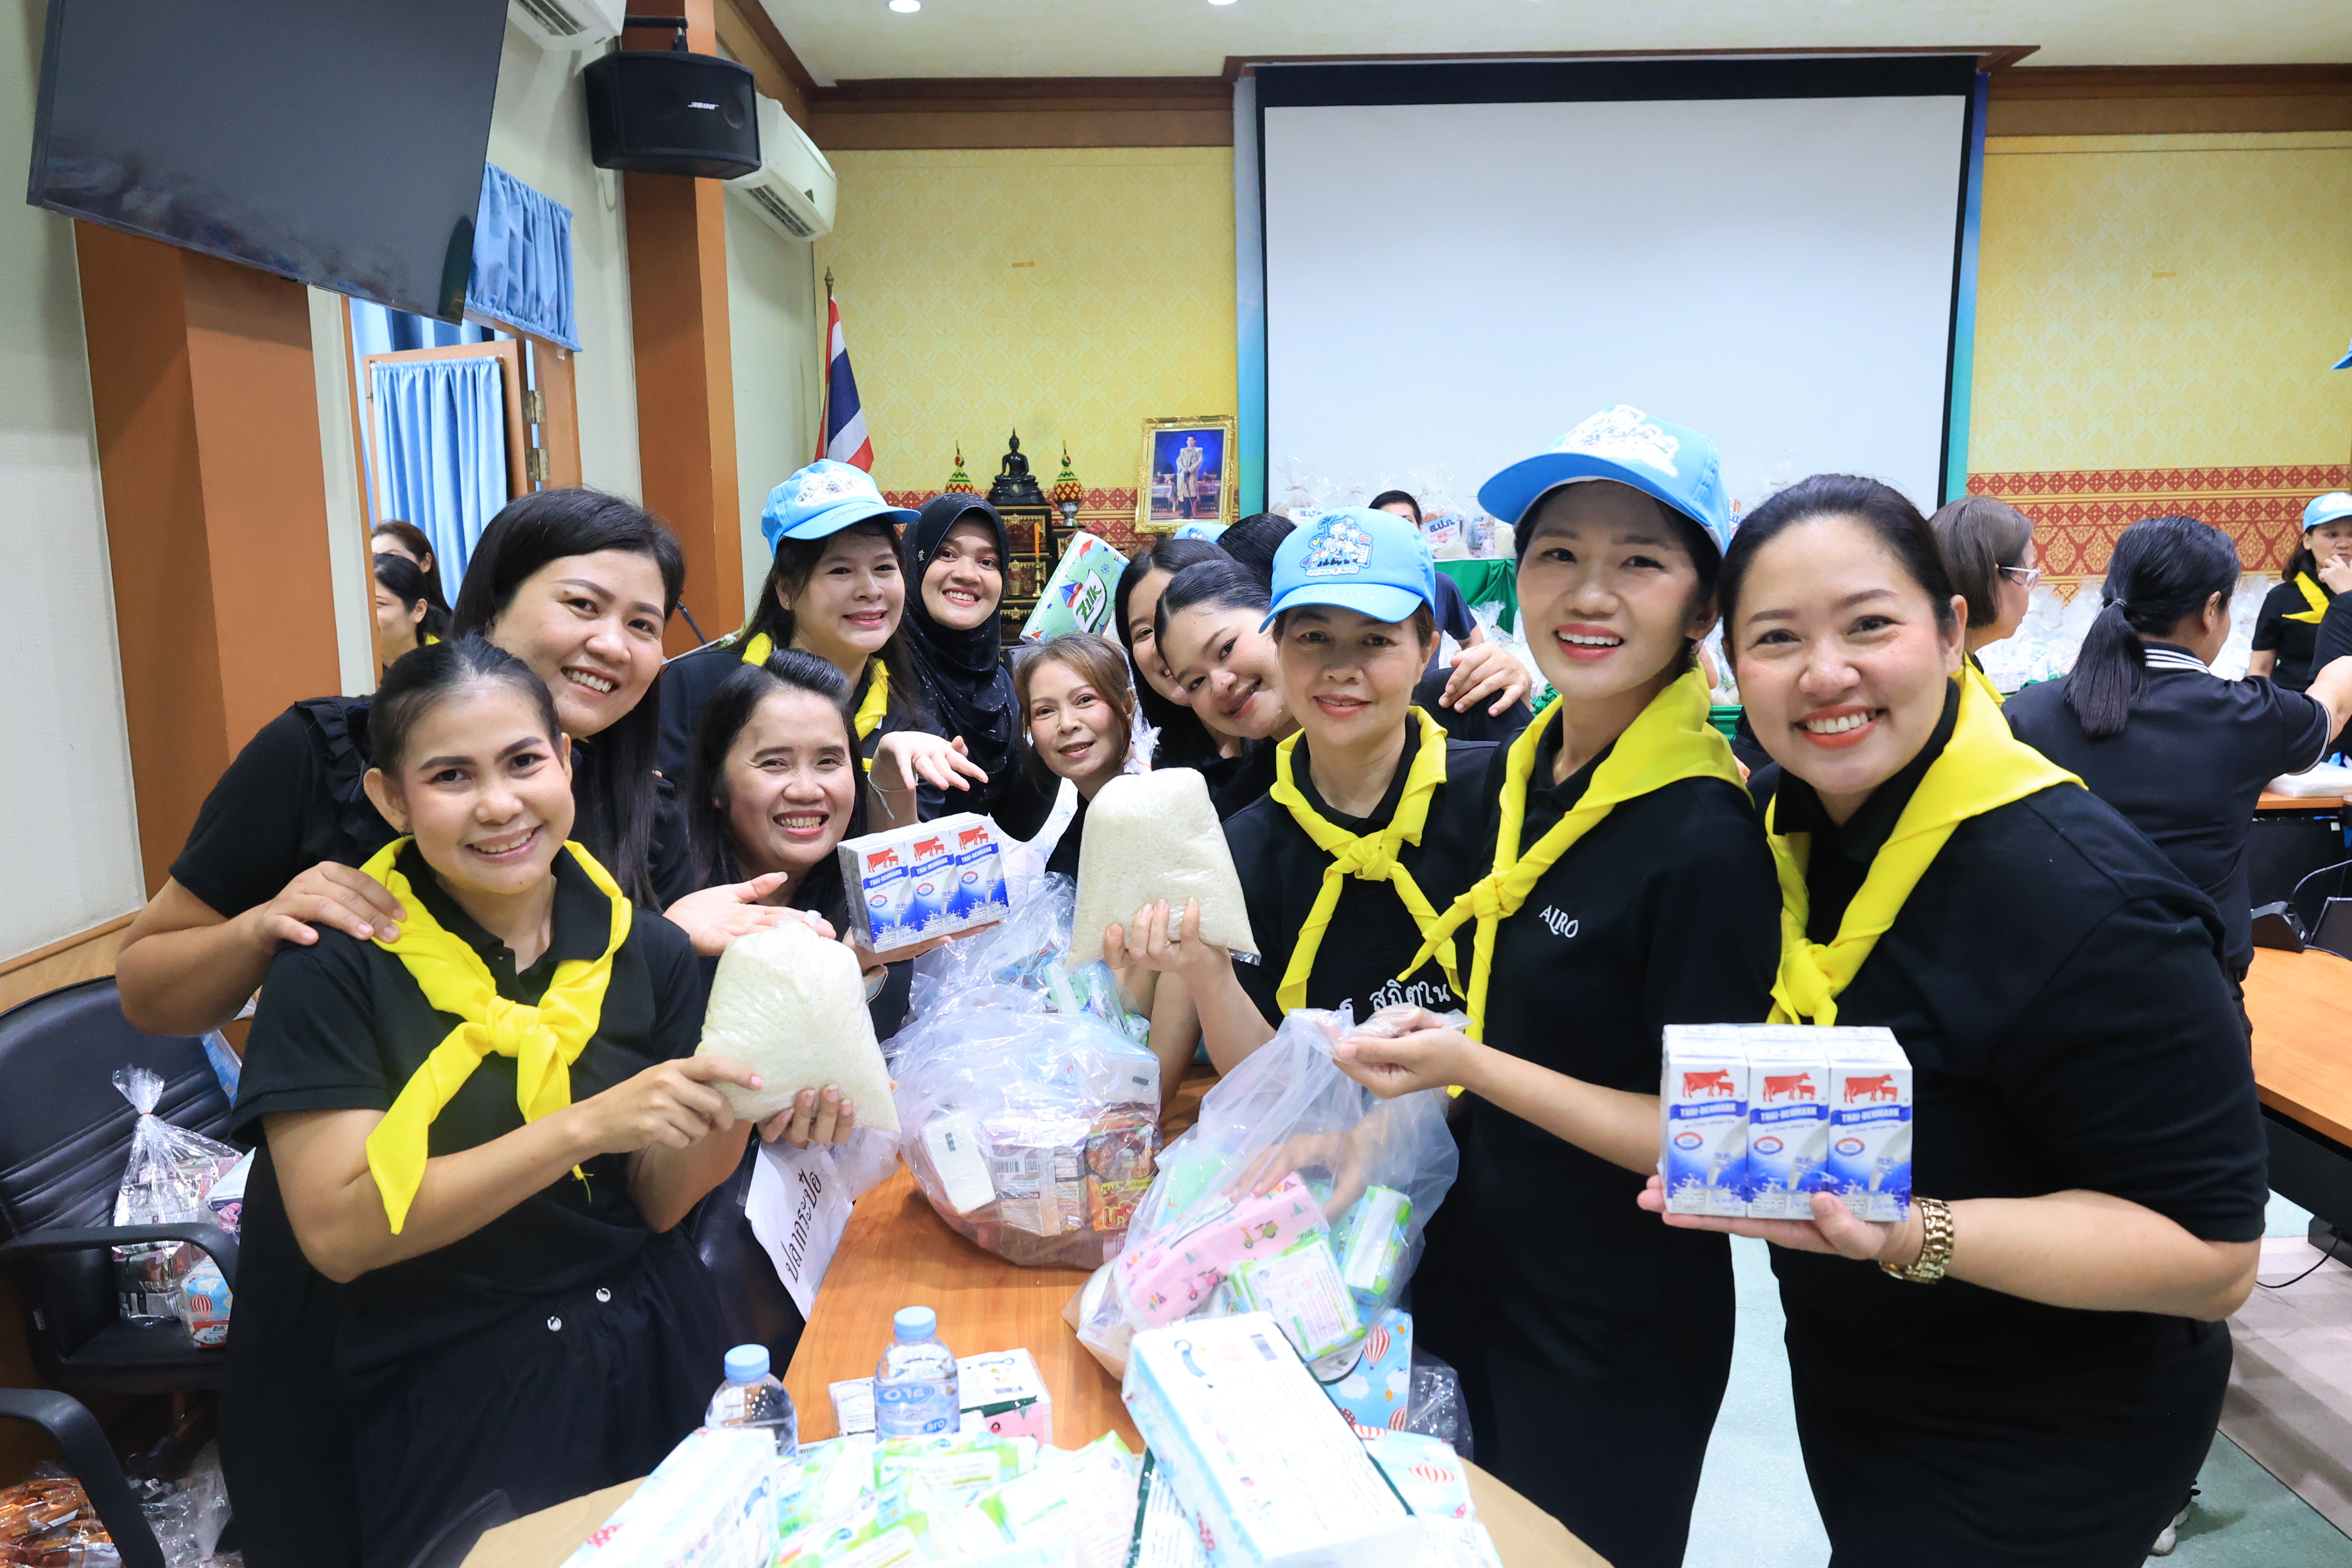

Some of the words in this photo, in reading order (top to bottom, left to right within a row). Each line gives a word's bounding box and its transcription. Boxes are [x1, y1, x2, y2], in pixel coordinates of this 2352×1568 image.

[688, 102, 719, 110] BOSE
[1429, 519, 1455, 533] ส.ป.ก.
[1076, 585, 1102, 623] Zilk
[961, 846, 992, 863] THAI-DENMARK
[916, 857, 948, 874] THAI-DENMARK
[869, 869, 903, 886] THAI-DENMARK
[1538, 904, 1579, 937] ALRO
[780, 1168, 821, 1284] ปลากระป๋อ
[926, 1420, 945, 1432] aro
